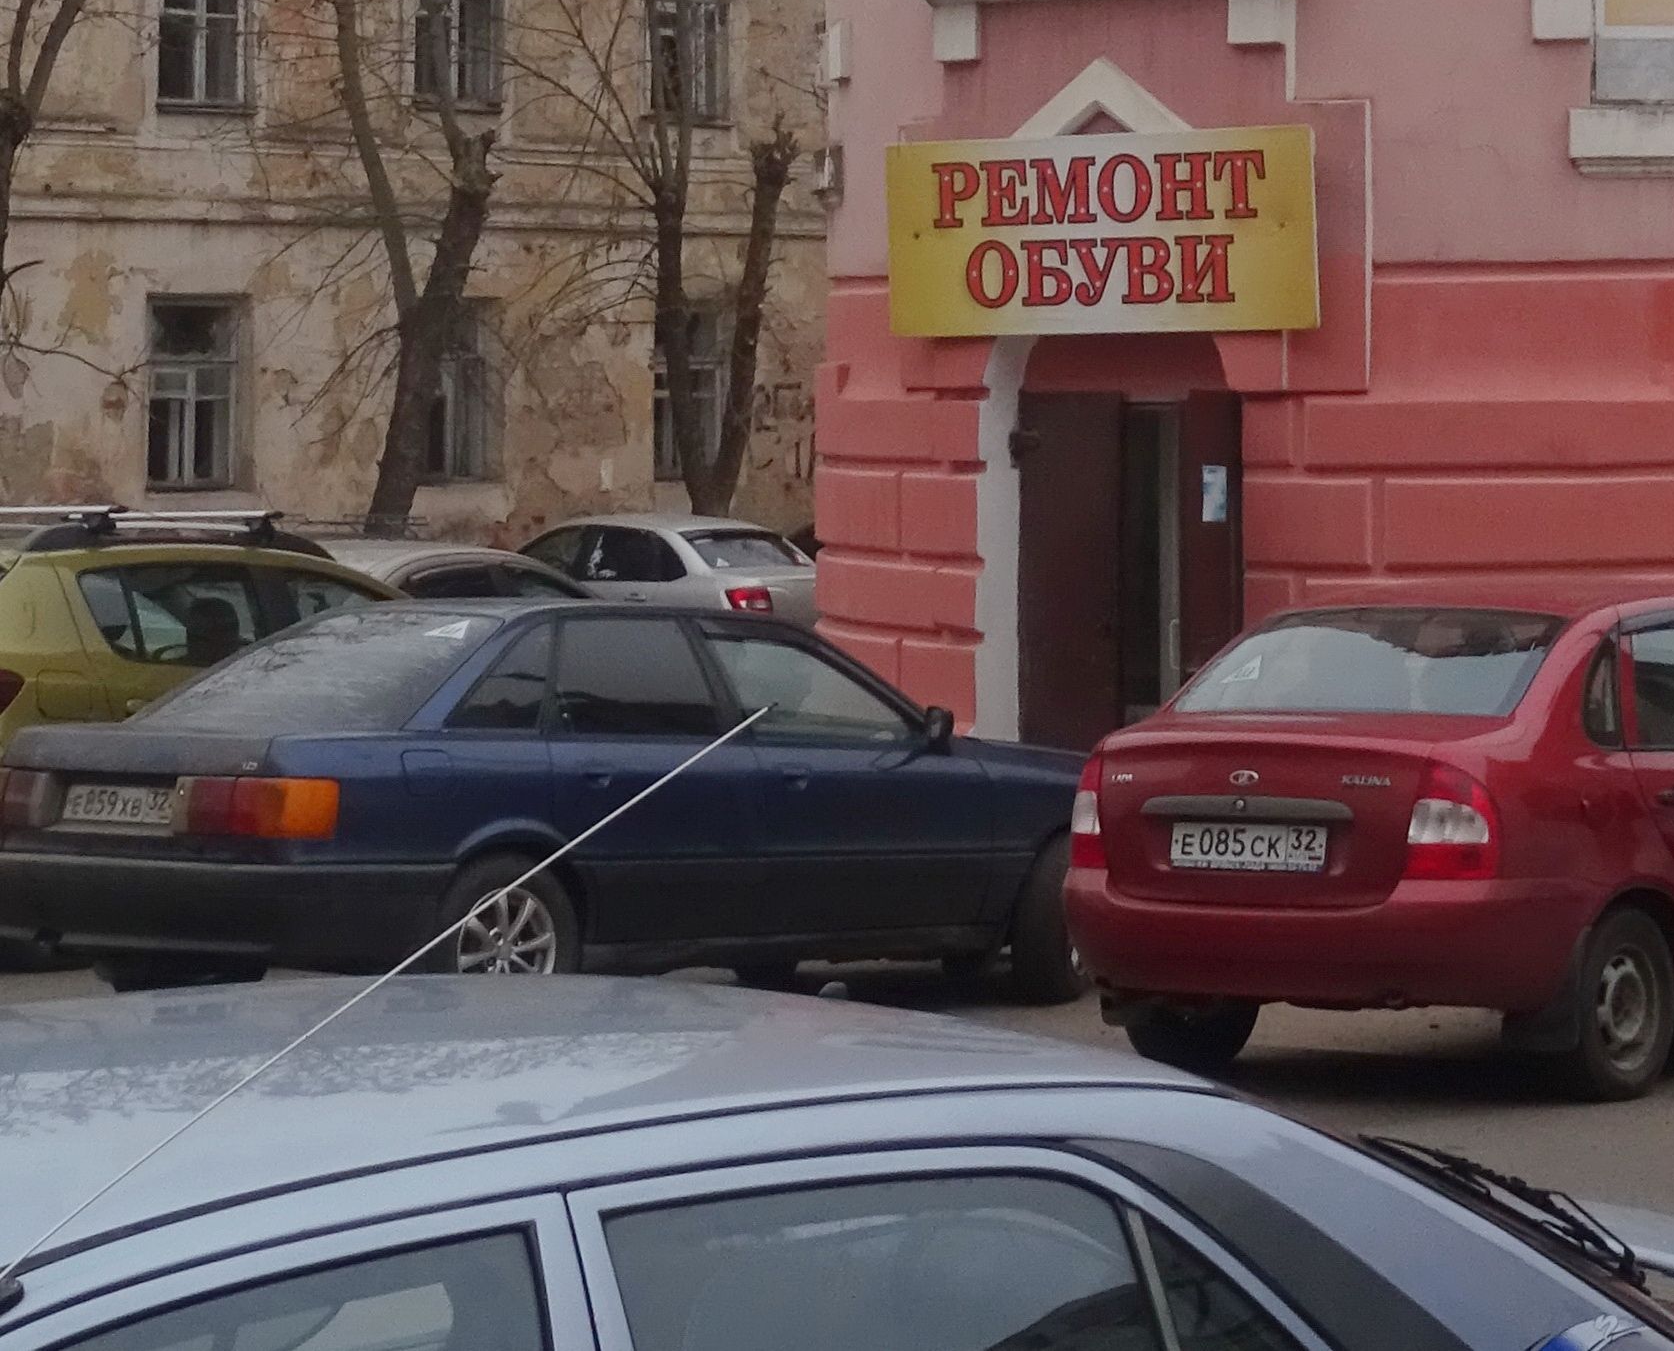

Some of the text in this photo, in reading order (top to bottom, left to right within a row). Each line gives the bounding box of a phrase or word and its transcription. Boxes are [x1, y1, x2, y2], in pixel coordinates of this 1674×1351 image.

[931, 149, 1266, 229] РЕМОНТ
[966, 233, 1237, 310] ОБУВИ
[1342, 774, 1391, 786] KALINA
[1290, 828, 1317, 852] 32
